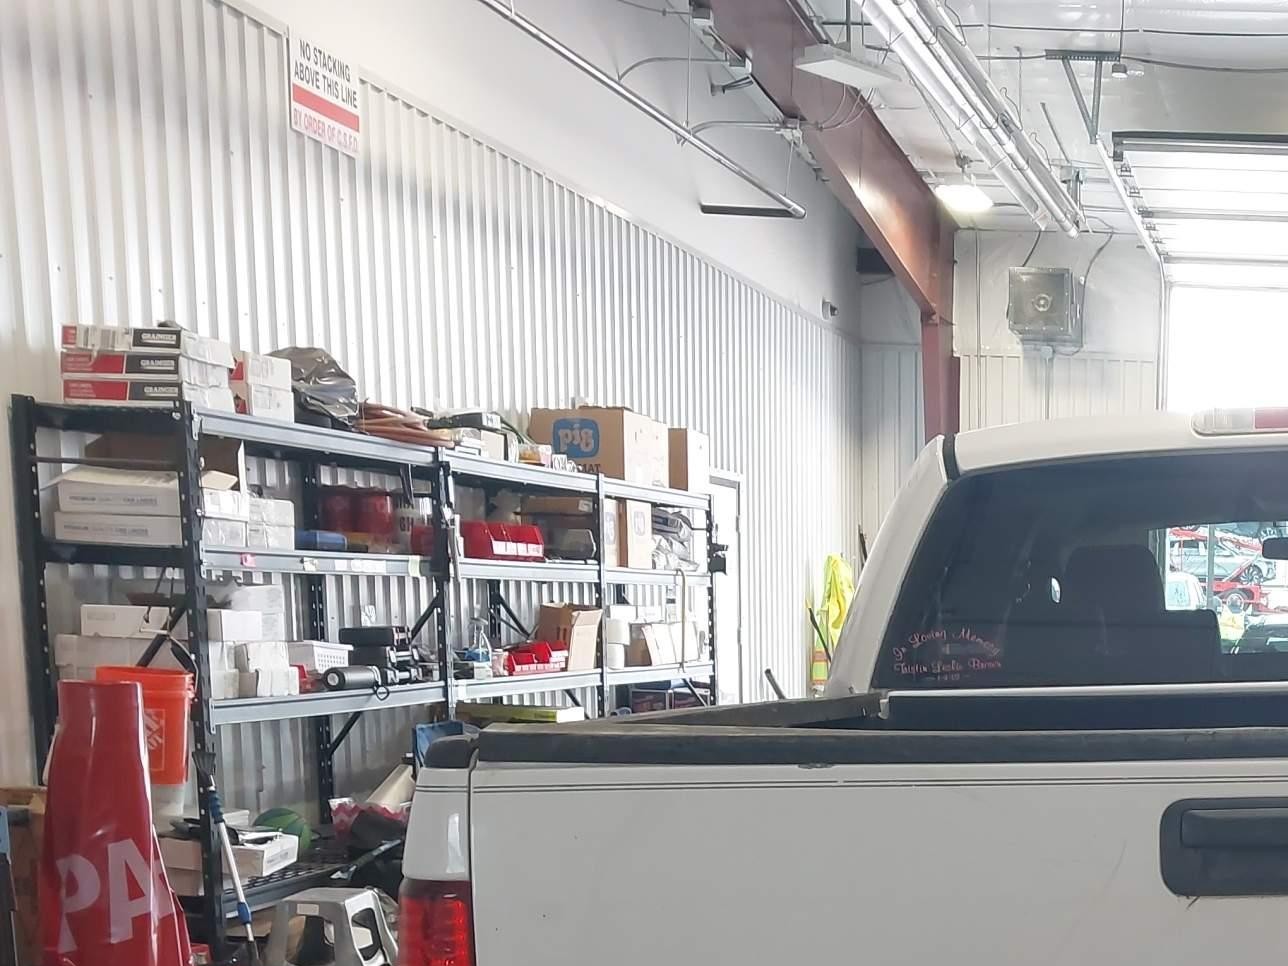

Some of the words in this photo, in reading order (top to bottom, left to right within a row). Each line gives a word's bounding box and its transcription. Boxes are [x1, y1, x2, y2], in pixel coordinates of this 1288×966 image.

[299, 40, 311, 61] NO
[313, 46, 351, 82] STACKING
[294, 60, 320, 90] ABOVE
[322, 74, 340, 100] THIS
[341, 86, 358, 109] LINE
[293, 107, 303, 126] BY
[303, 113, 326, 138] ORDER
[327, 124, 337, 143] OF
